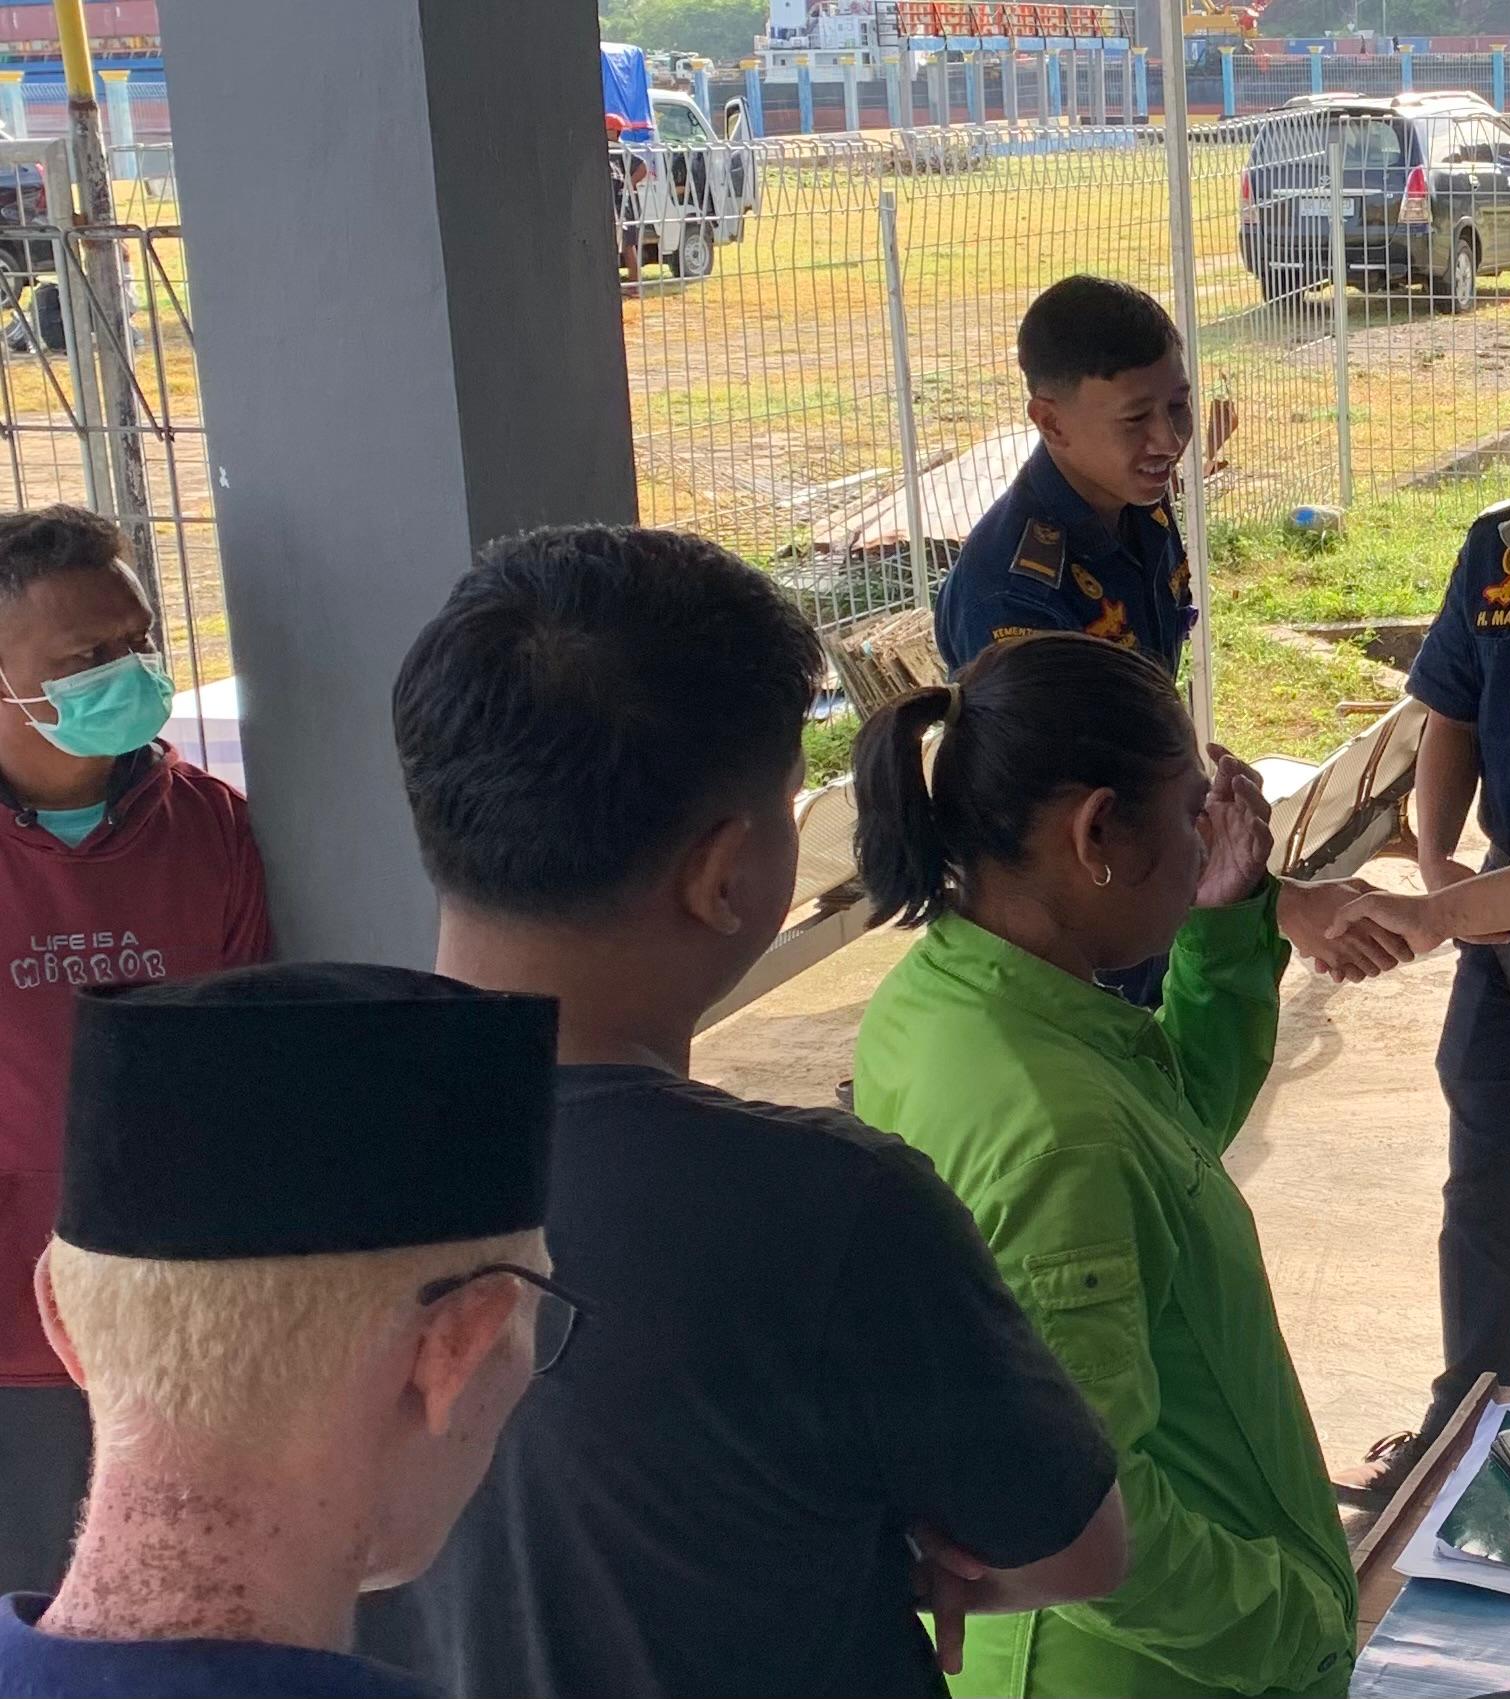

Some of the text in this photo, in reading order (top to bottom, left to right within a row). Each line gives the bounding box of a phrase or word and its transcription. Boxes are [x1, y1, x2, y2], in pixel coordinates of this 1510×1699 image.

[1476, 611, 1488, 627] H.
[31, 930, 139, 951] LIFE IS A
